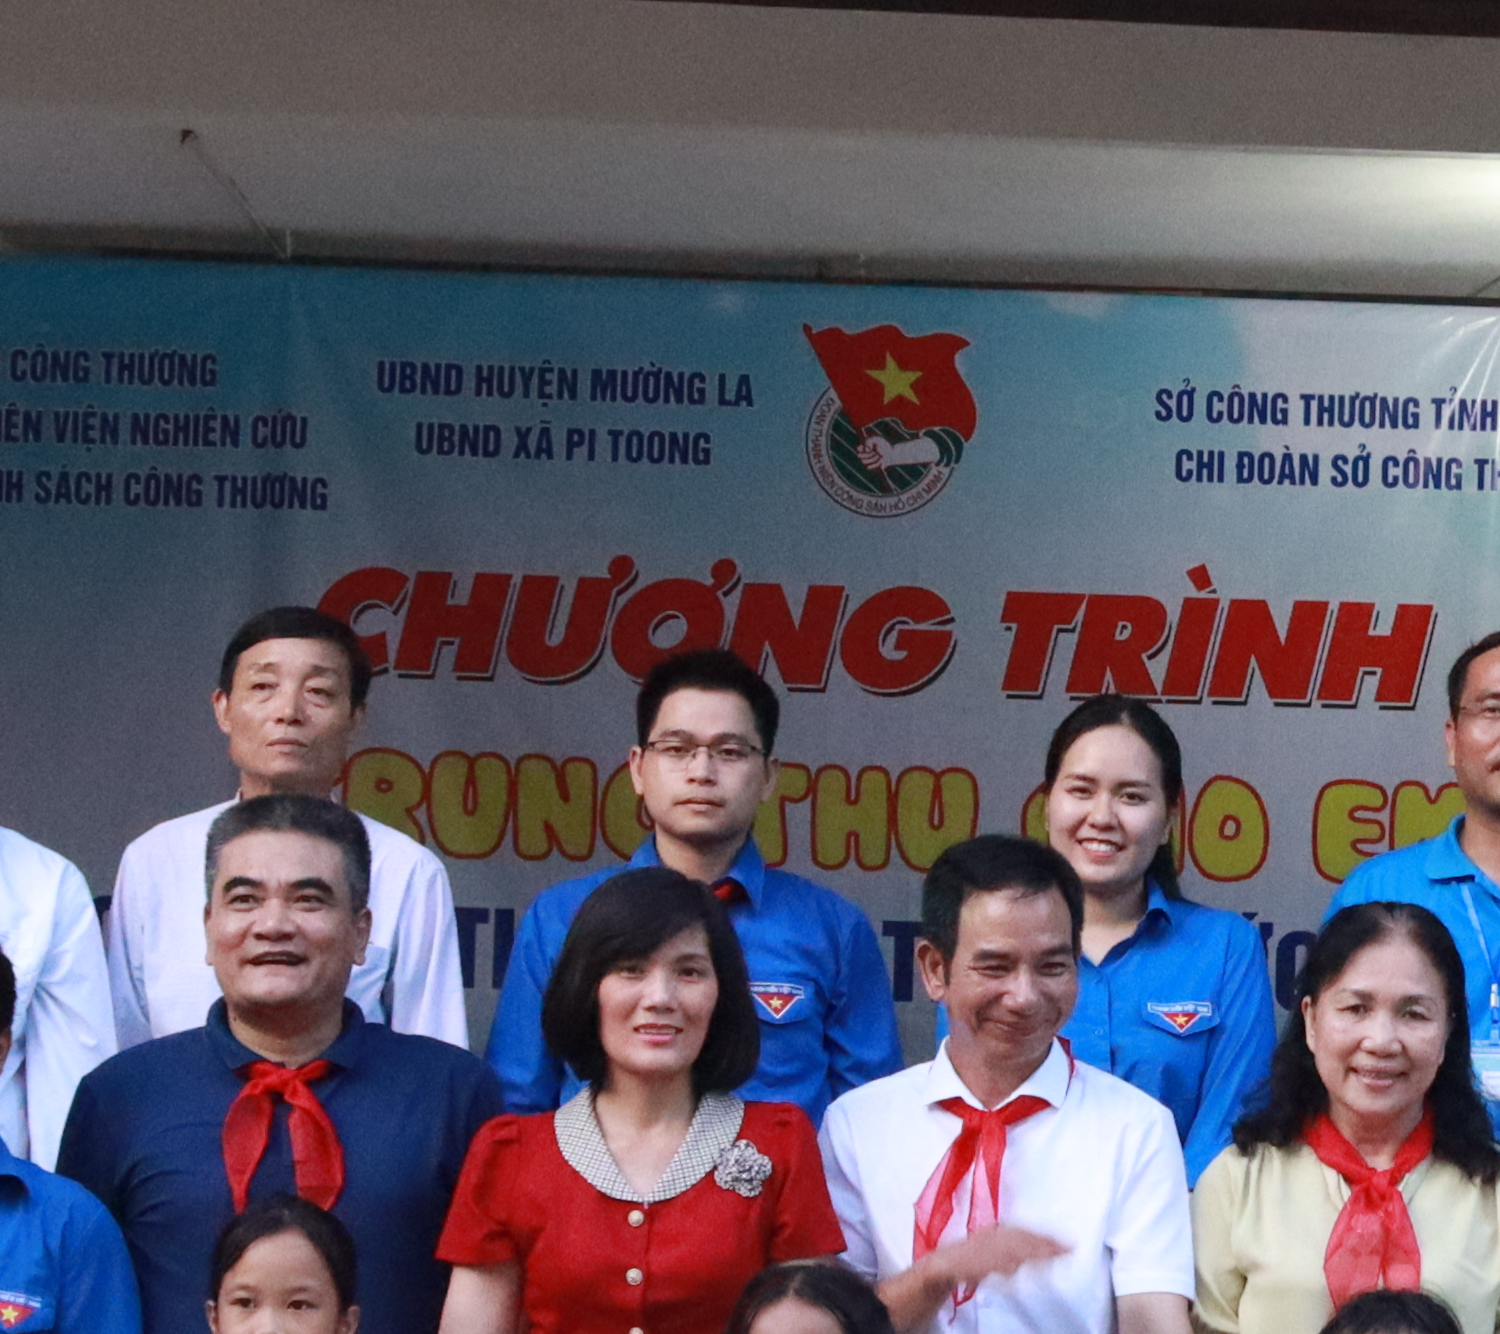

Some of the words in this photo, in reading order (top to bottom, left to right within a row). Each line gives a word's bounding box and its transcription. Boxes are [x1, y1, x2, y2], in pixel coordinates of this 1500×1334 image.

[10, 343, 92, 386] CÔNG
[101, 345, 219, 391] THƯƠNG
[376, 359, 463, 403] UBND
[470, 361, 582, 411] HUYỆN
[588, 358, 709, 409] MƯỜNG
[716, 372, 756, 409] LA
[52, 401, 123, 454] VIỆN
[129, 405, 244, 450] NGHIÊN
[250, 403, 310, 452] CỨU
[1153, 376, 1198, 427] SỞ
[1205, 379, 1292, 429] CÔNG
[1298, 388, 1423, 435] THƯƠNG
[1430, 383, 1500, 437] TỈNH
[413, 421, 504, 460] UBND
[511, 421, 556, 462] XÃ
[563, 425, 600, 463] PI
[607, 427, 713, 467] TOONG
[1172, 447, 1227, 487] CHI
[1235, 442, 1322, 491] ĐOÀN
[1329, 437, 1376, 493] SỞ
[1381, 443, 1471, 496] CÔNG
[33, 464, 114, 510] SÁCH
[121, 466, 204, 510] CÔNG
[211, 469, 330, 513] THƯƠNG
[316, 553, 957, 699] CHƯƠNG
[997, 563, 1438, 711] TRÌNH
[338, 746, 655, 861] RUN
